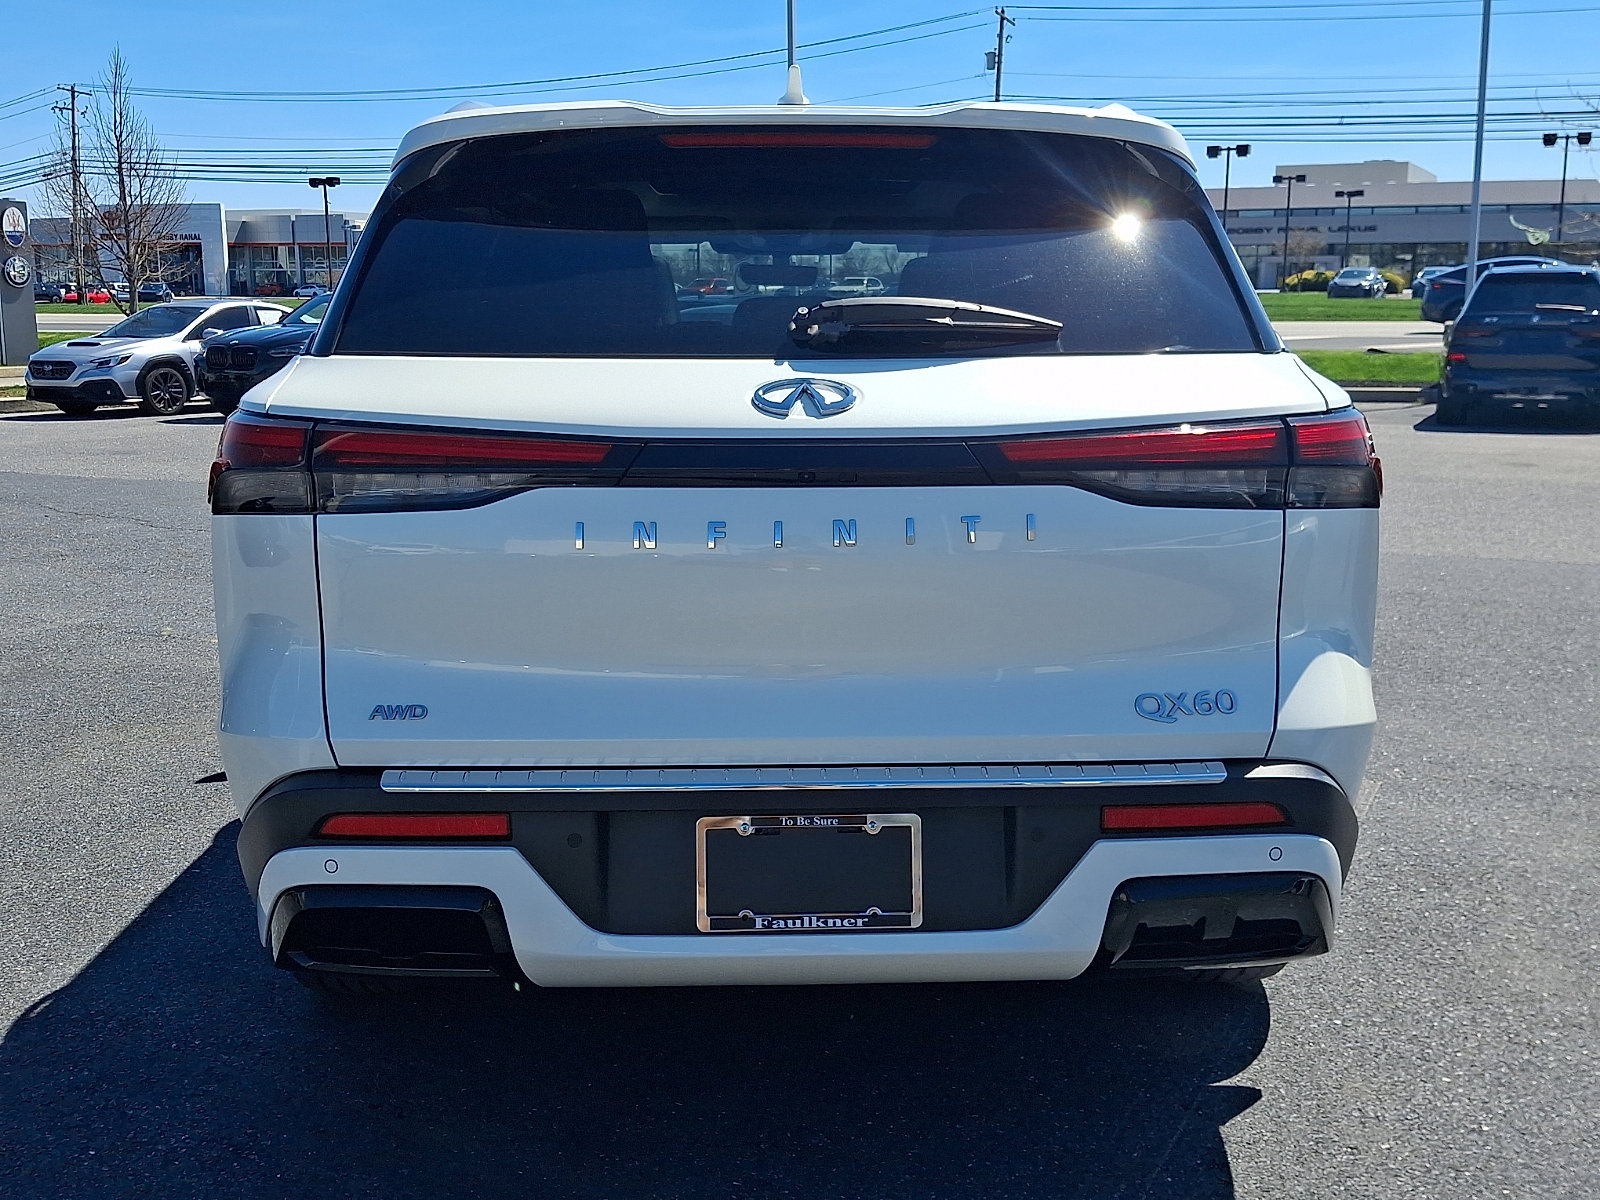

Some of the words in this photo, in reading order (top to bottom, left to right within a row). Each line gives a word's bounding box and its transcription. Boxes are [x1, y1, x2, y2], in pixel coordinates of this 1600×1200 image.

[575, 513, 1036, 549] INFINITI
[368, 704, 428, 720] AWD
[1135, 689, 1238, 723] QX60
[780, 817, 794, 826] To
[797, 816, 810, 826] Be
[813, 816, 839, 826] Sure
[755, 916, 869, 929] Faulkner
